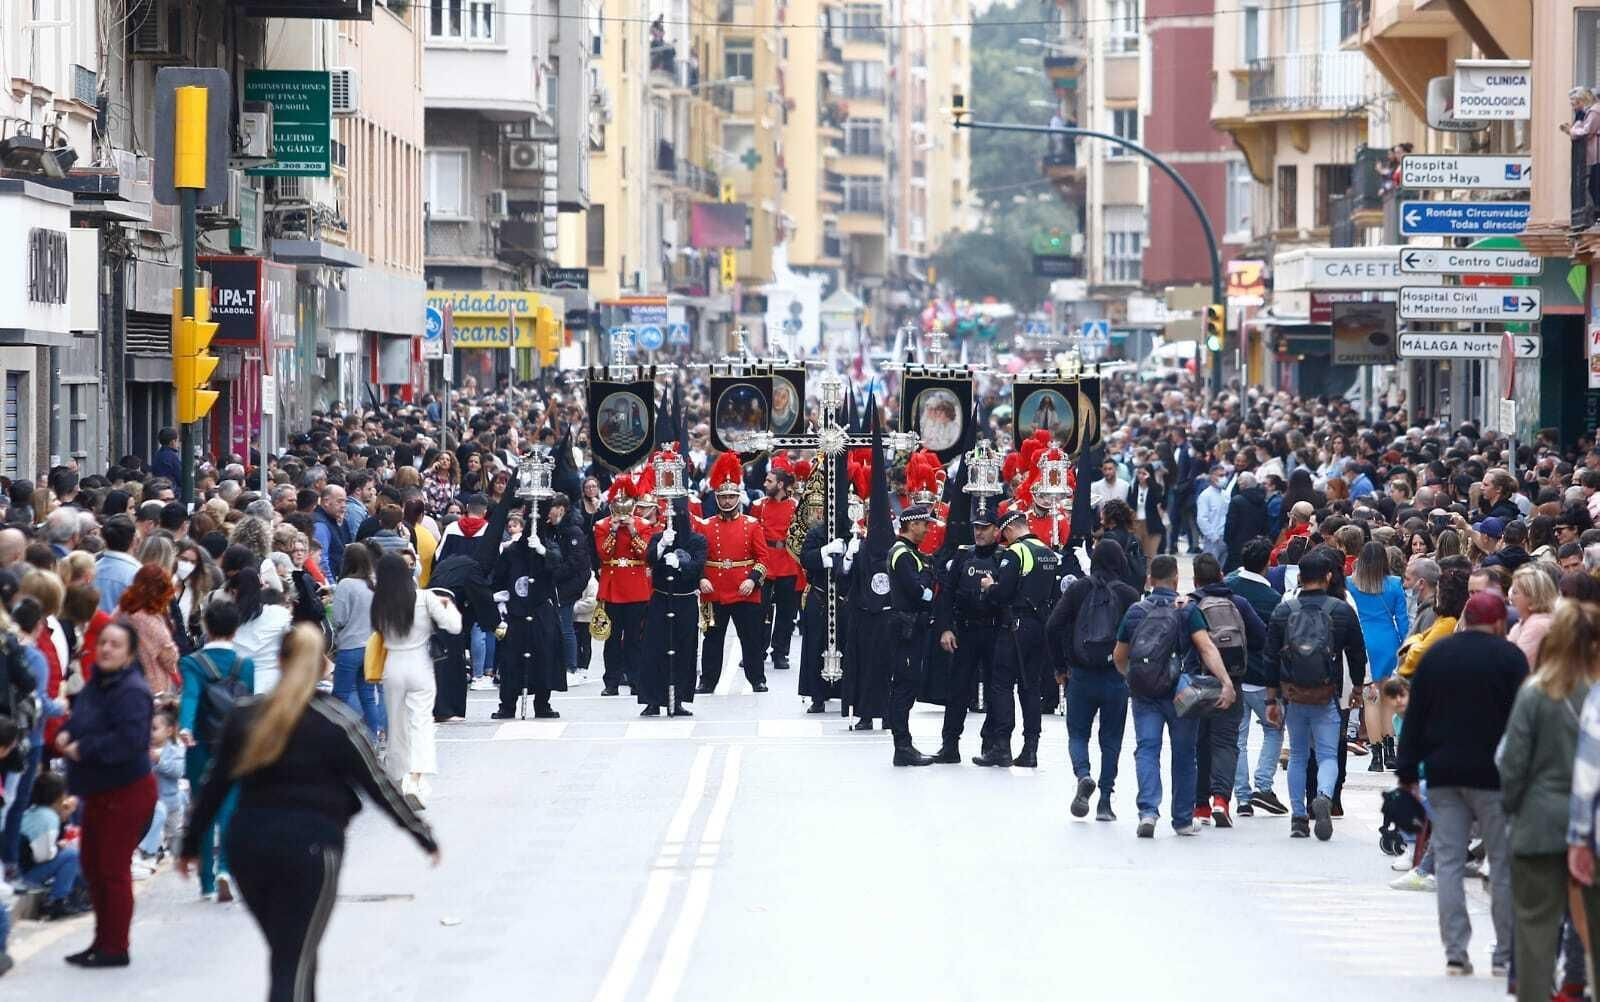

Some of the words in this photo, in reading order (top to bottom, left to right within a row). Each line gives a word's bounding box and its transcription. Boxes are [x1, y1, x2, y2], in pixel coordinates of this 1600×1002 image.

[1486, 76, 1527, 86] CLINICA
[247, 83, 326, 91] ADMINISTRACIONES
[278, 93, 308, 101] FINCAS
[274, 133, 315, 142] LLERMO
[287, 144, 325, 153] GÁLVEZ
[1405, 160, 1458, 171] Hospital
[1405, 172, 1444, 183] Carlos
[1450, 174, 1480, 184] Haya
[1426, 208, 1463, 217] Rondas
[1466, 208, 1530, 218] Circunvalaci
[1450, 220, 1479, 229] Todas
[1483, 220, 1525, 229] direccion
[1449, 256, 1490, 267] Centro
[1496, 257, 1539, 268] Ciudad
[1325, 263, 1401, 277] CAFETE
[1402, 292, 1448, 302] Hospital
[1453, 292, 1477, 302] Civil
[1402, 305, 1458, 314] H.Materno
[1462, 304, 1500, 314] Infantil
[1402, 337, 1458, 351] MÁLAGA
